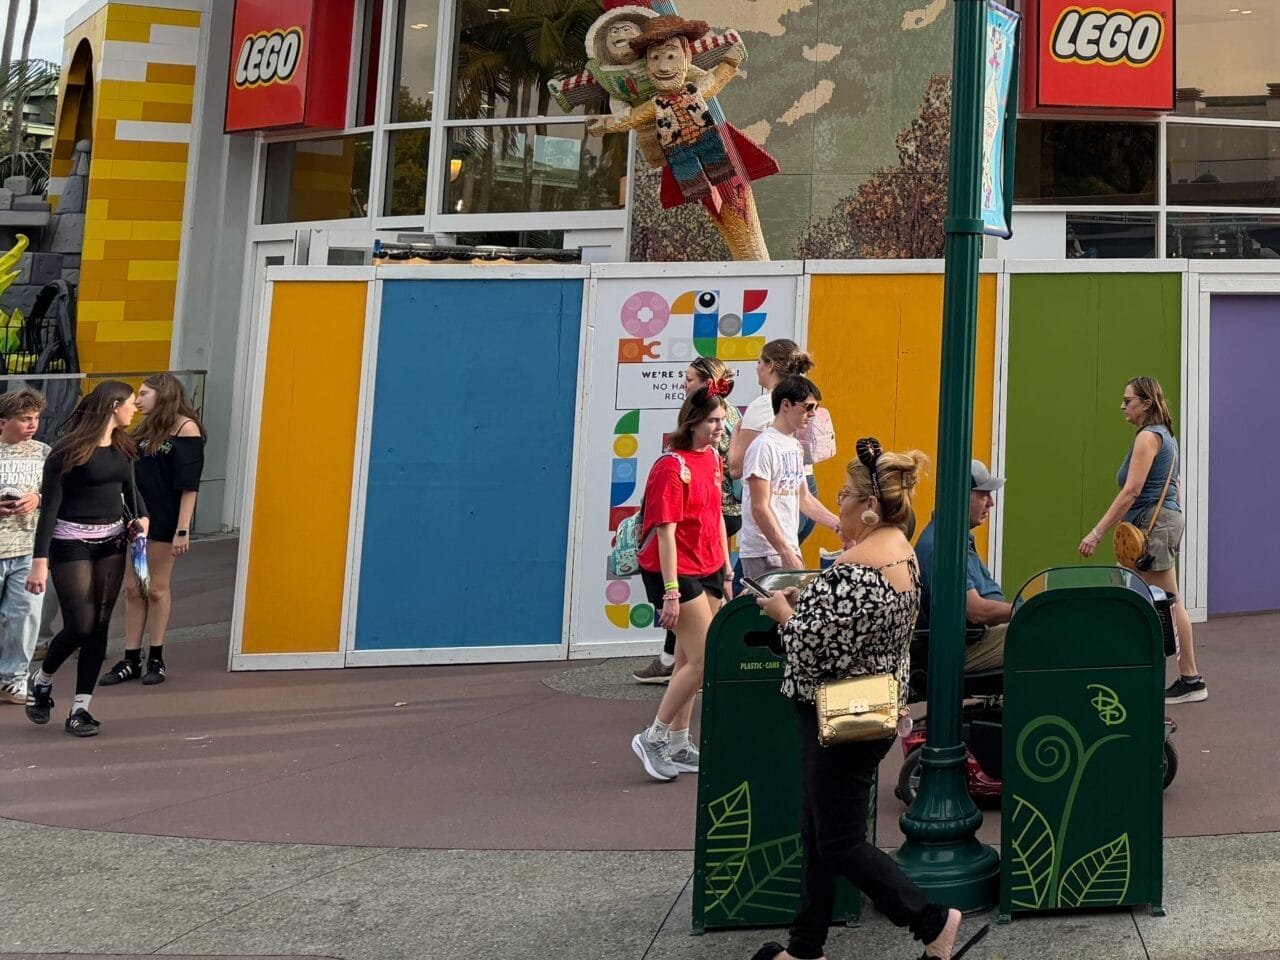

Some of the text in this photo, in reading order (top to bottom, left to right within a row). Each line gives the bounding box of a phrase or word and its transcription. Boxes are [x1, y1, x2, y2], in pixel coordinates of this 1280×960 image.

[1052, 8, 1162, 65] LEGO
[235, 28, 302, 87] LEGO
[642, 370, 674, 379] WE'RE
[652, 382, 688, 391] NO HA
[664, 392, 687, 401] REQ
[740, 661, 780, 670] PLASTIC CANS
